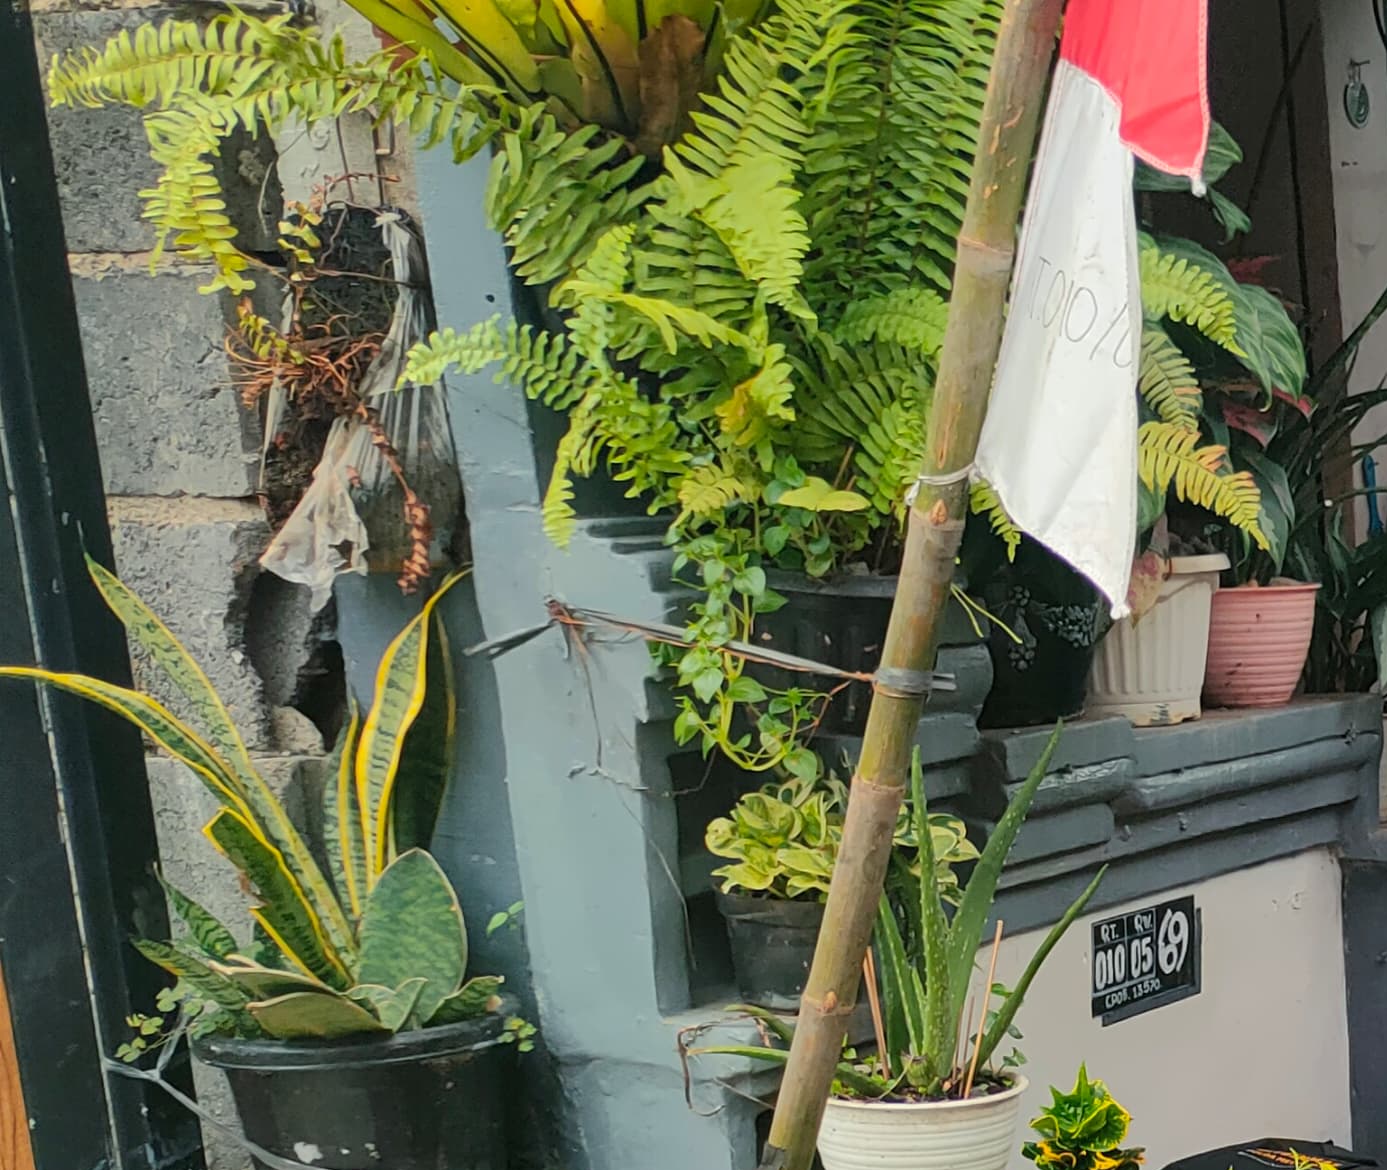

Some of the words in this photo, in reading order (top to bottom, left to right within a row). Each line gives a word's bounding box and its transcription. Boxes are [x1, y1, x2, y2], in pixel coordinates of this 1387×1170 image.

[1101, 923, 1119, 943] RT.
[1158, 908, 1189, 974] 69
[1095, 944, 1126, 990] 010
[1130, 936, 1153, 978] 05
